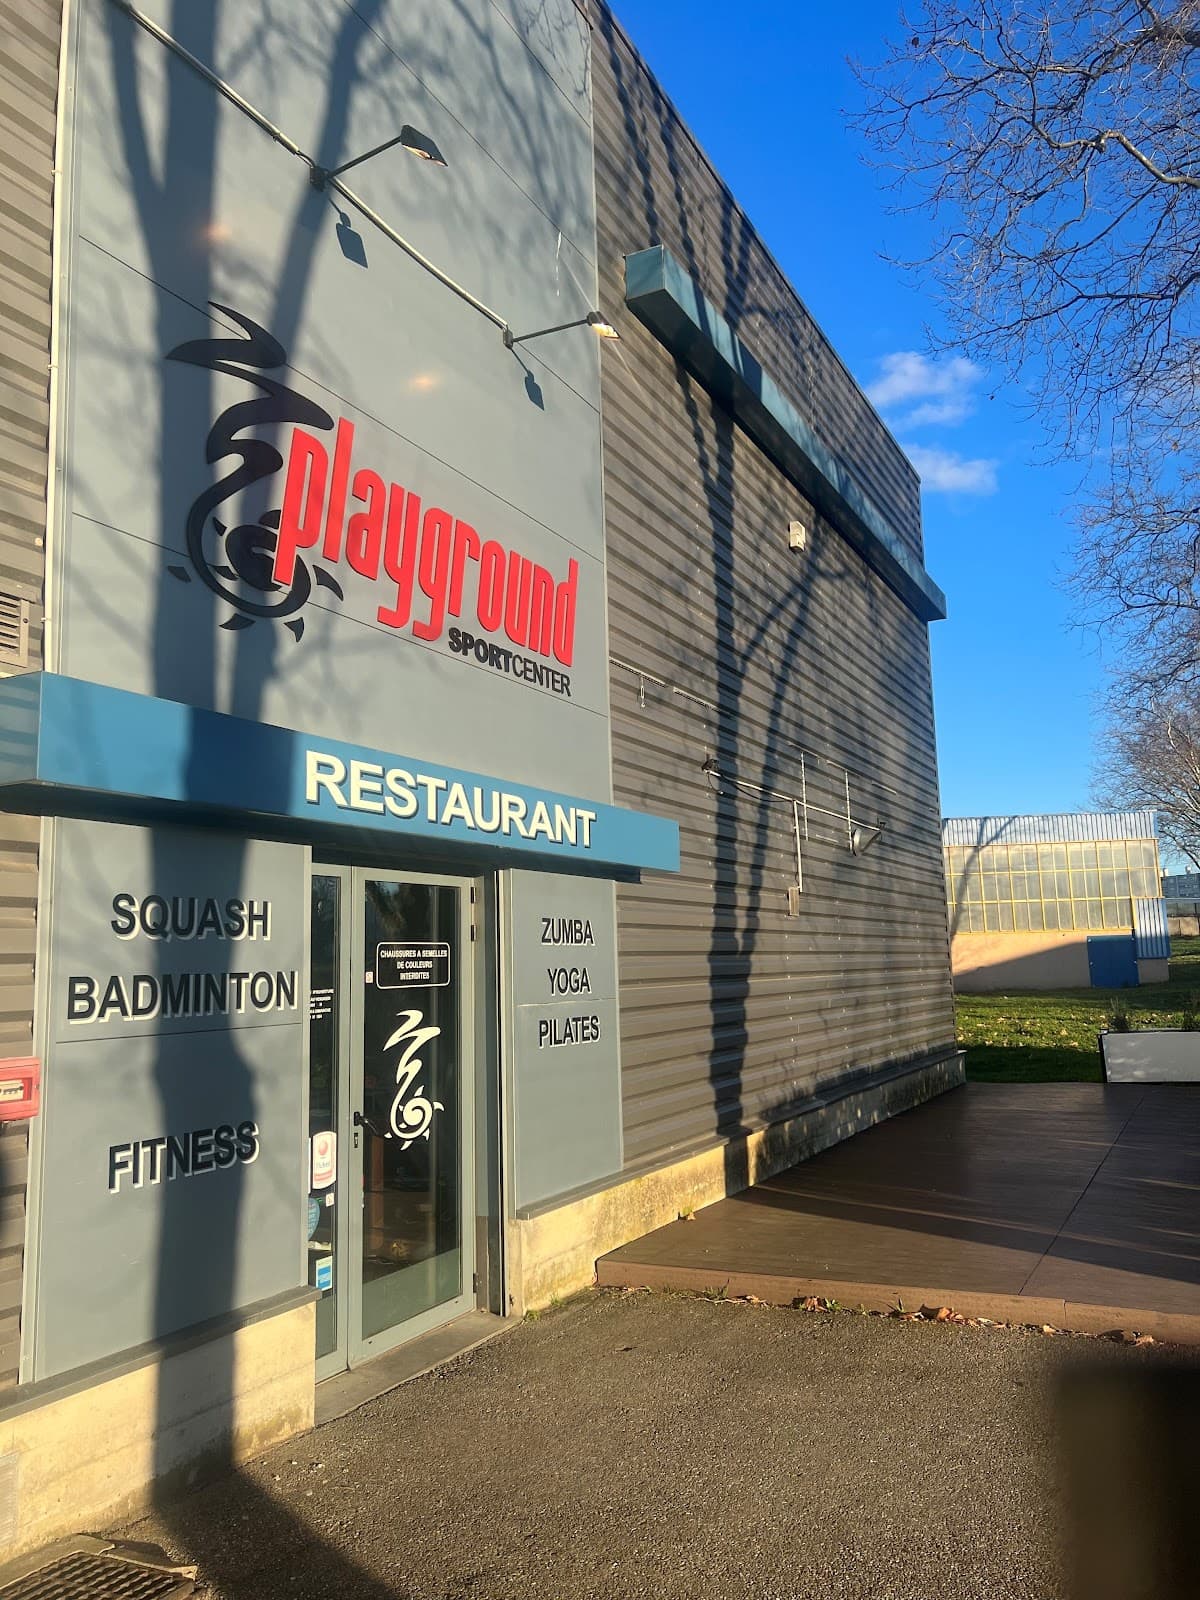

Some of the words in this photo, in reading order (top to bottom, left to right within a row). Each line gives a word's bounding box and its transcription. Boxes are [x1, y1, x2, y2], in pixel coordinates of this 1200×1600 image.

[273, 416, 579, 668] playground
[448, 627, 572, 697] SPORTCENTER
[305, 750, 597, 848] RESTAURANT
[111, 893, 273, 941] SQUASH
[541, 917, 596, 946] ZUMBA
[380, 949, 417, 958] CHAUSSURES
[422, 949, 448, 958] SEMELLES
[396, 961, 405, 969] DE
[67, 970, 299, 1024] BADMINTON
[547, 967, 592, 996] YOGA
[538, 1015, 600, 1049] PILATES
[108, 1120, 259, 1194] FITNESS
